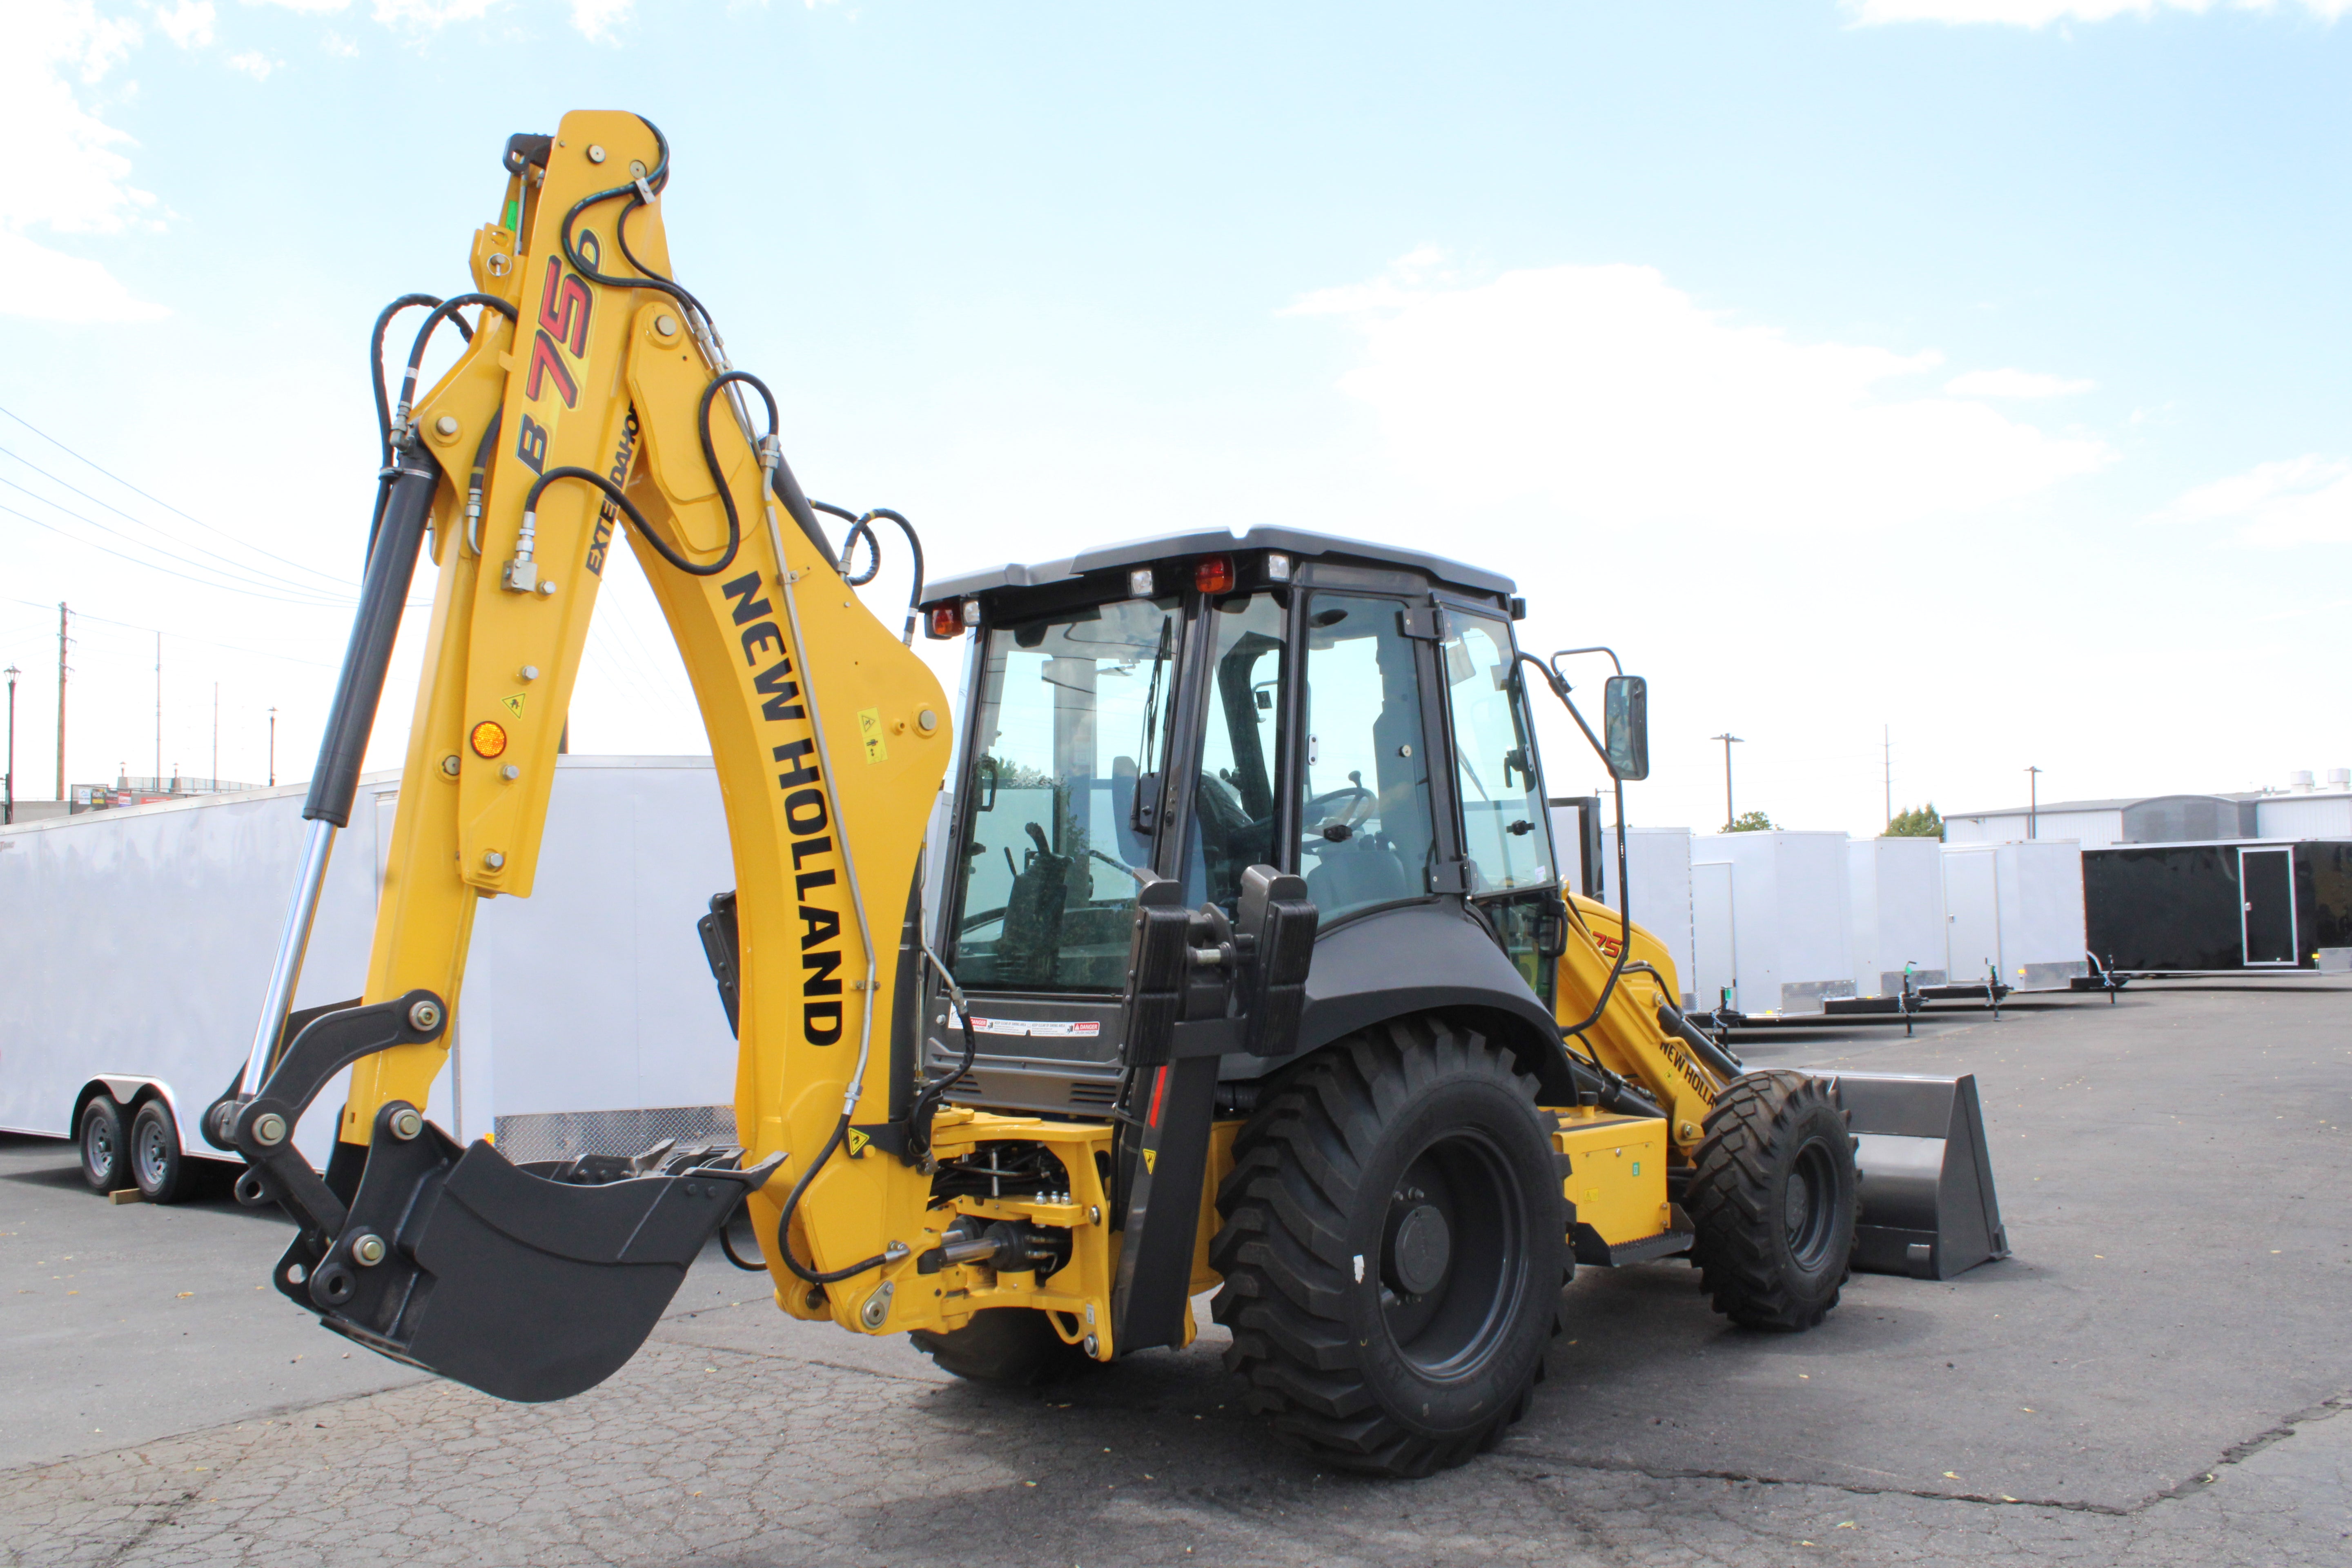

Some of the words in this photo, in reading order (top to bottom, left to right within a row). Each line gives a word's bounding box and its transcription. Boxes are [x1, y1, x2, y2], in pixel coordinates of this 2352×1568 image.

[586, 399, 640, 576] EXTEDAHO
[722, 571, 806, 722] NEW
[772, 737, 842, 1046] HOLLAND
[1660, 1042, 1686, 1072] NEW
[1684, 1064, 1717, 1109] HOLLA
